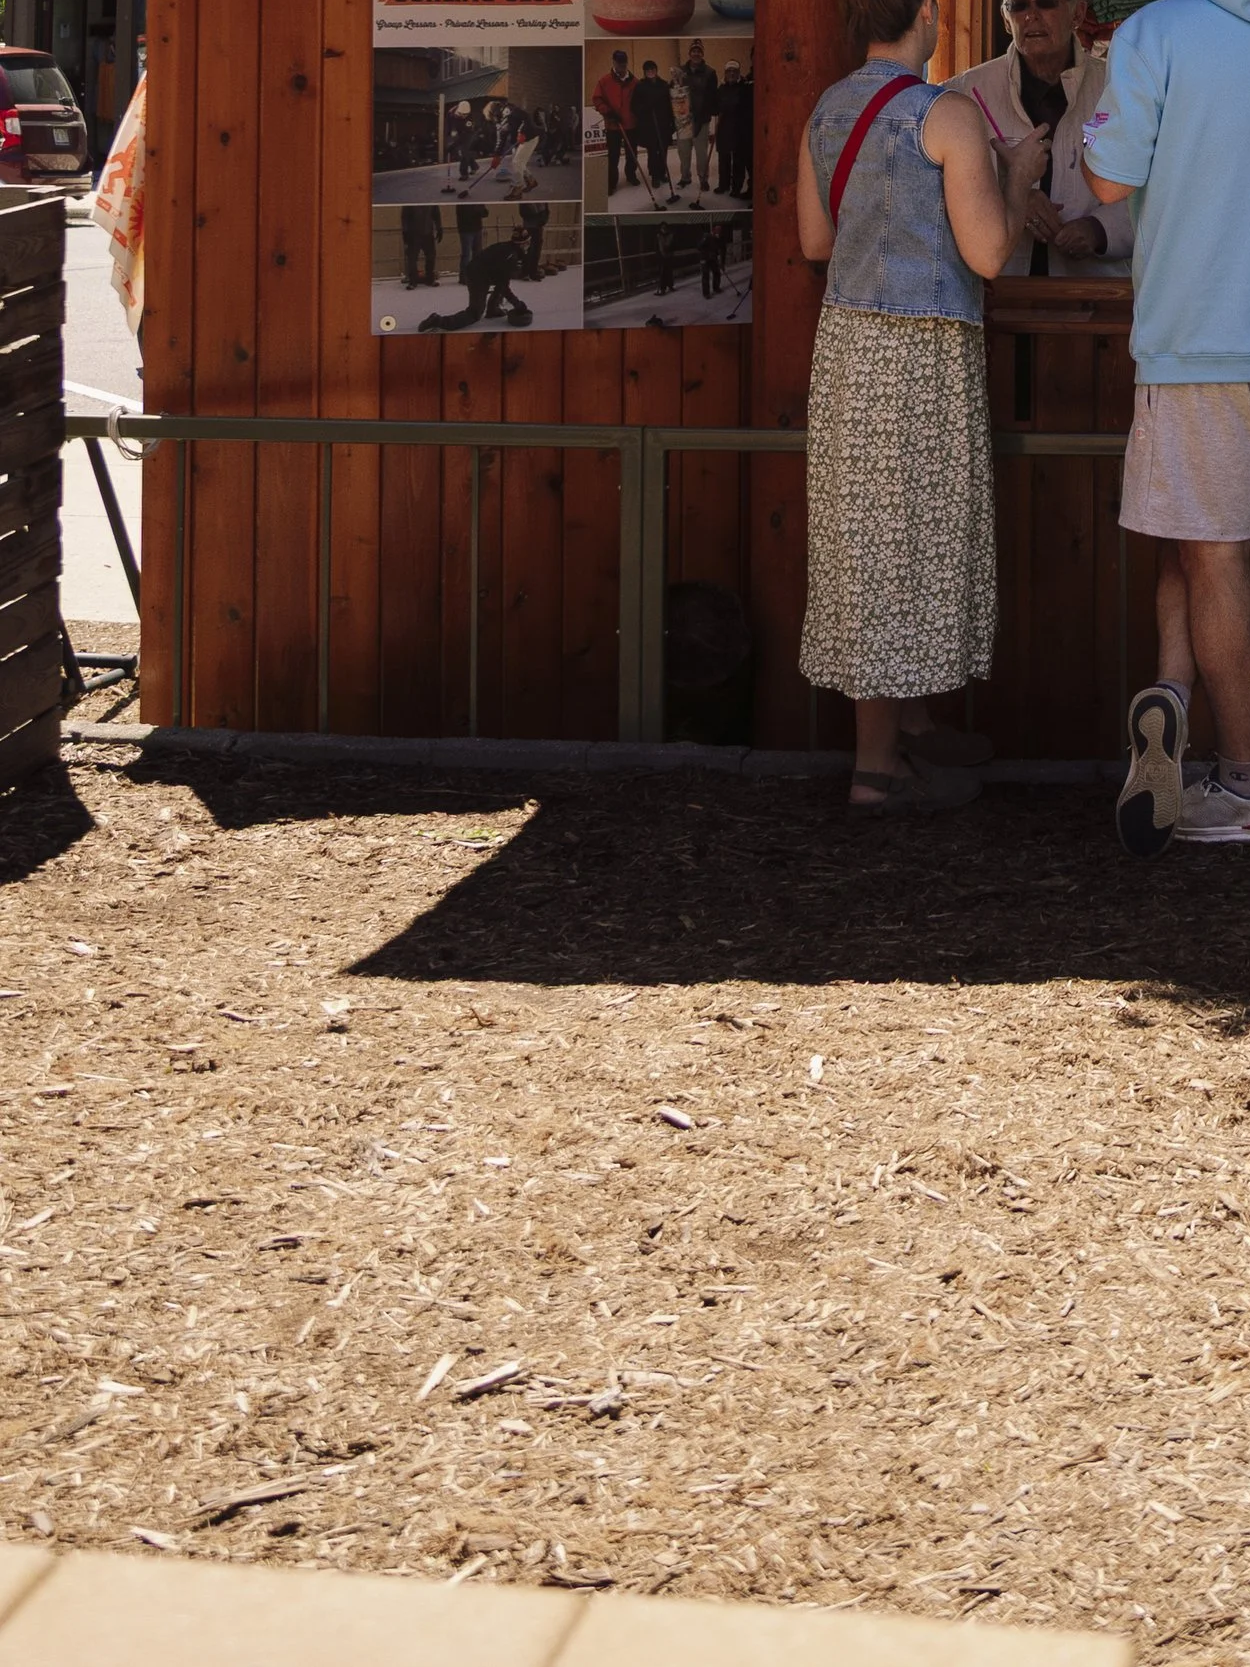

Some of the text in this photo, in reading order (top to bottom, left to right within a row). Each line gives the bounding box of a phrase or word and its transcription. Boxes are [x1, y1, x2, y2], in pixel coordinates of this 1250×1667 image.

[376, 18, 580, 31] Group Lessons Private Lessons Curling League
